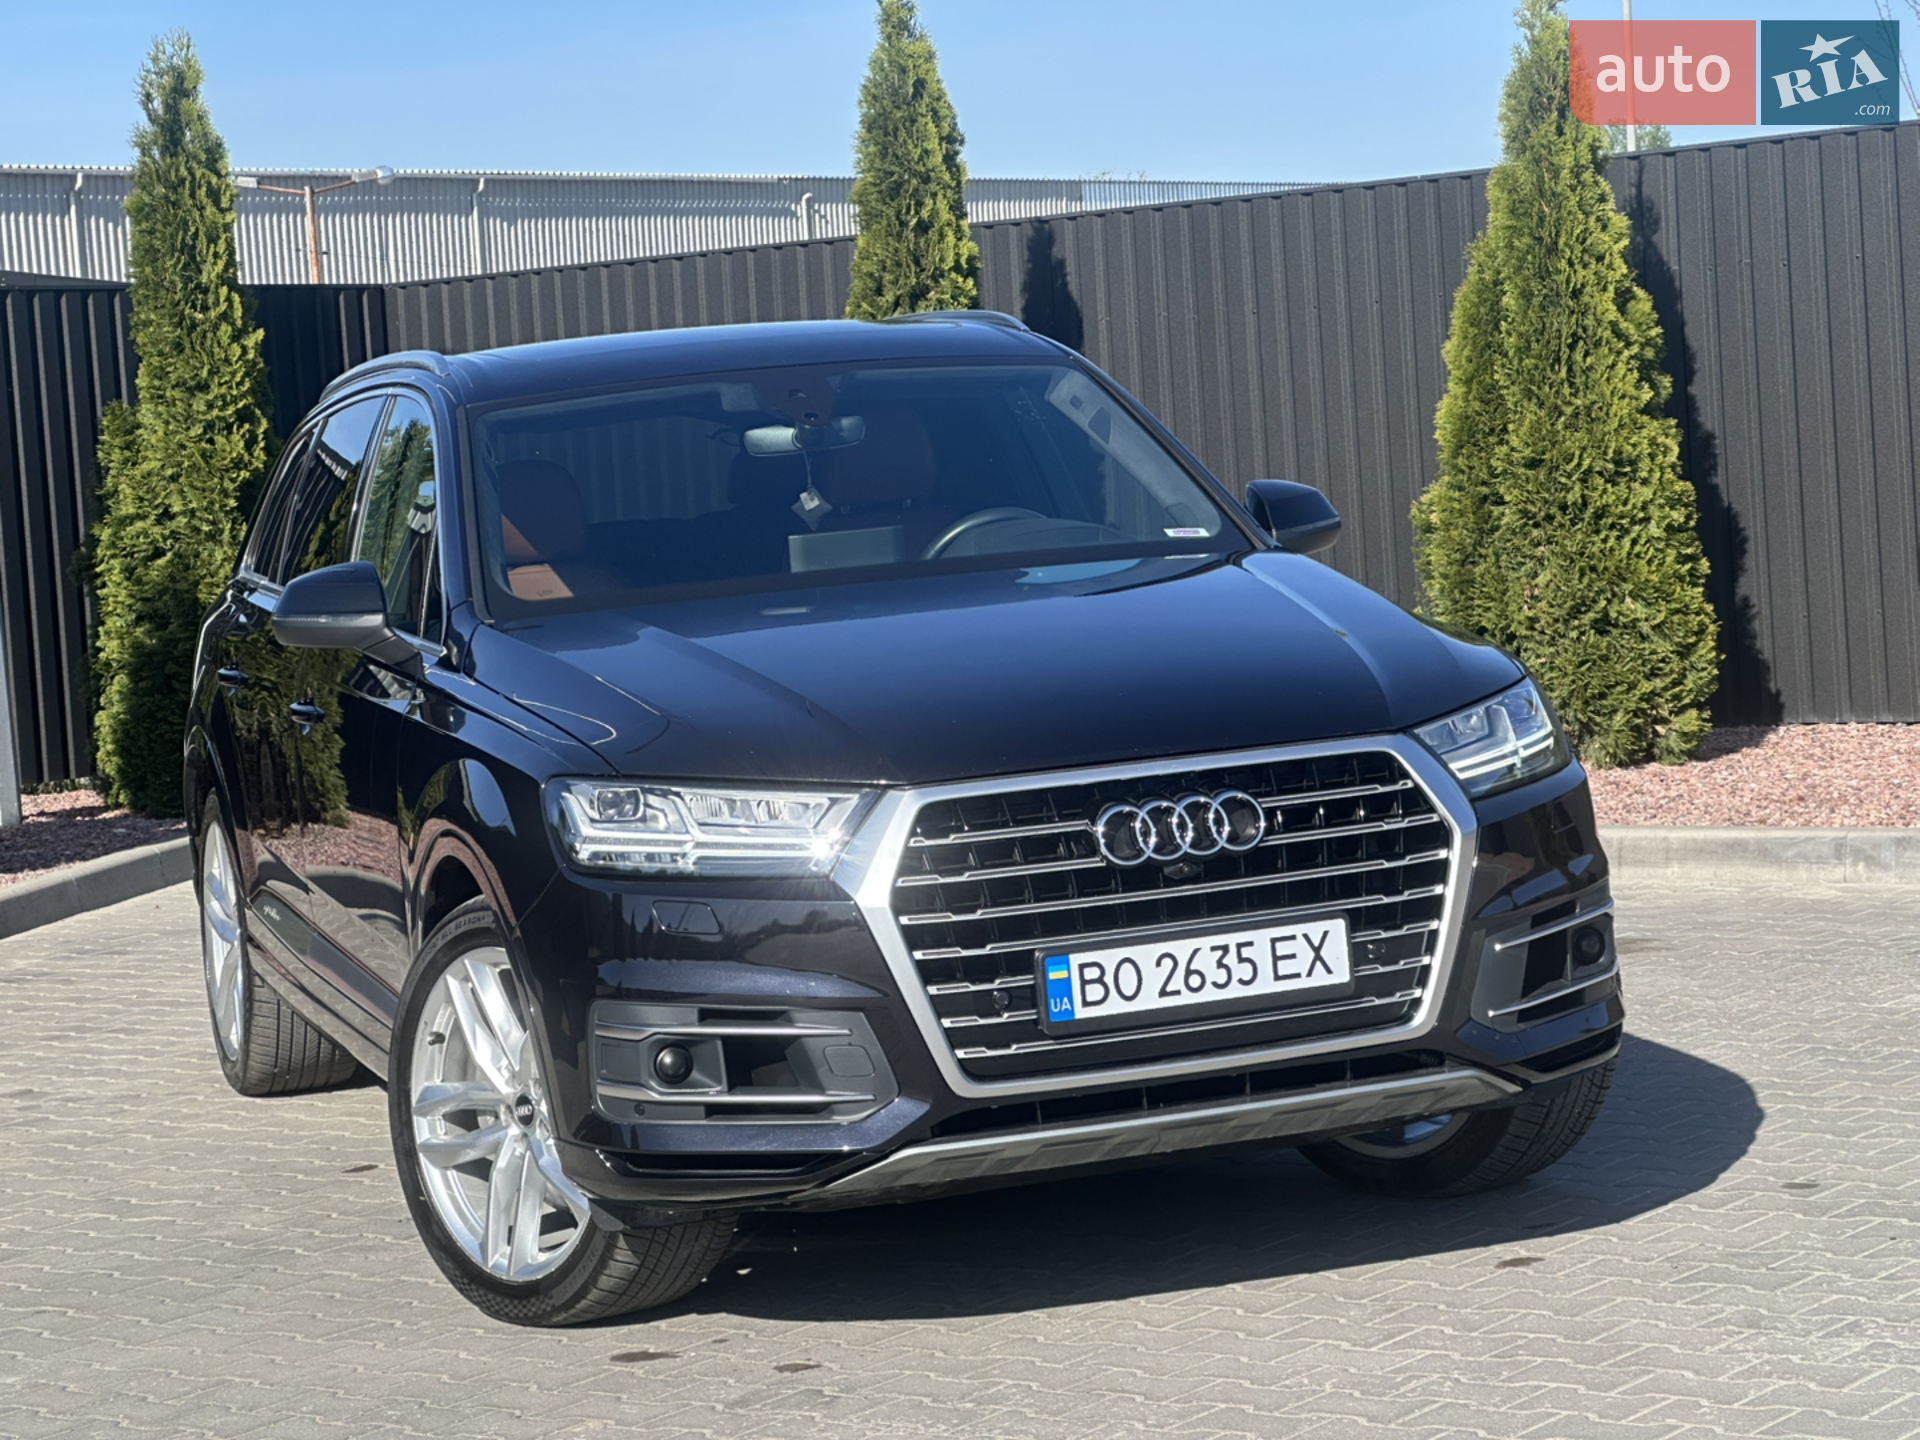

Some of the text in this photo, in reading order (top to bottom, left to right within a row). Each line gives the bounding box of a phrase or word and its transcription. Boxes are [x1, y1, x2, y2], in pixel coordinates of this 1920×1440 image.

[1078, 930, 1333, 1008] BO 2635 EX
[1051, 996, 1072, 1012] UA
